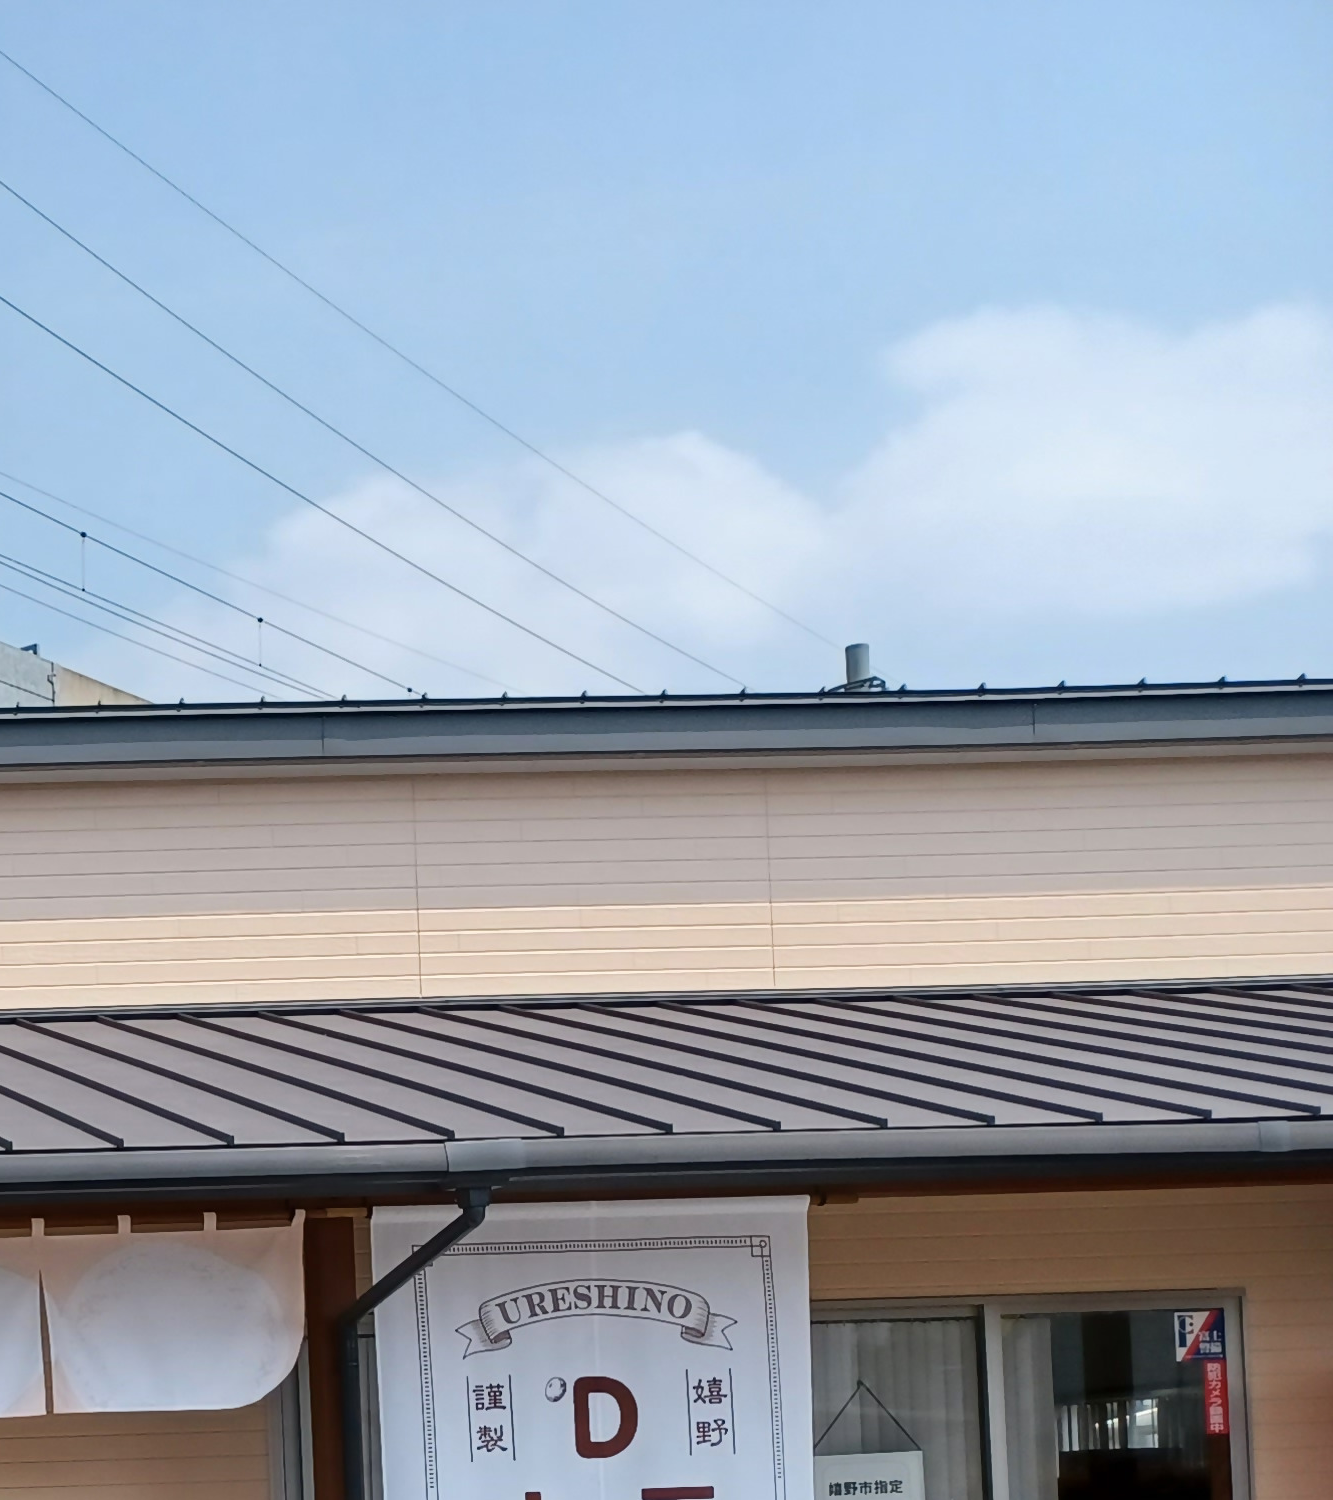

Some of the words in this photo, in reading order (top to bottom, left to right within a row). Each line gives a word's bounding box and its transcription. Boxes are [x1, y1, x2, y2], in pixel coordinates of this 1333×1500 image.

[494, 1284, 693, 1325] URESHINO
[472, 1382, 509, 1453] 謹製
[692, 1376, 729, 1448] 嬉野
[828, 1479, 904, 1497] 嬉野市指定
